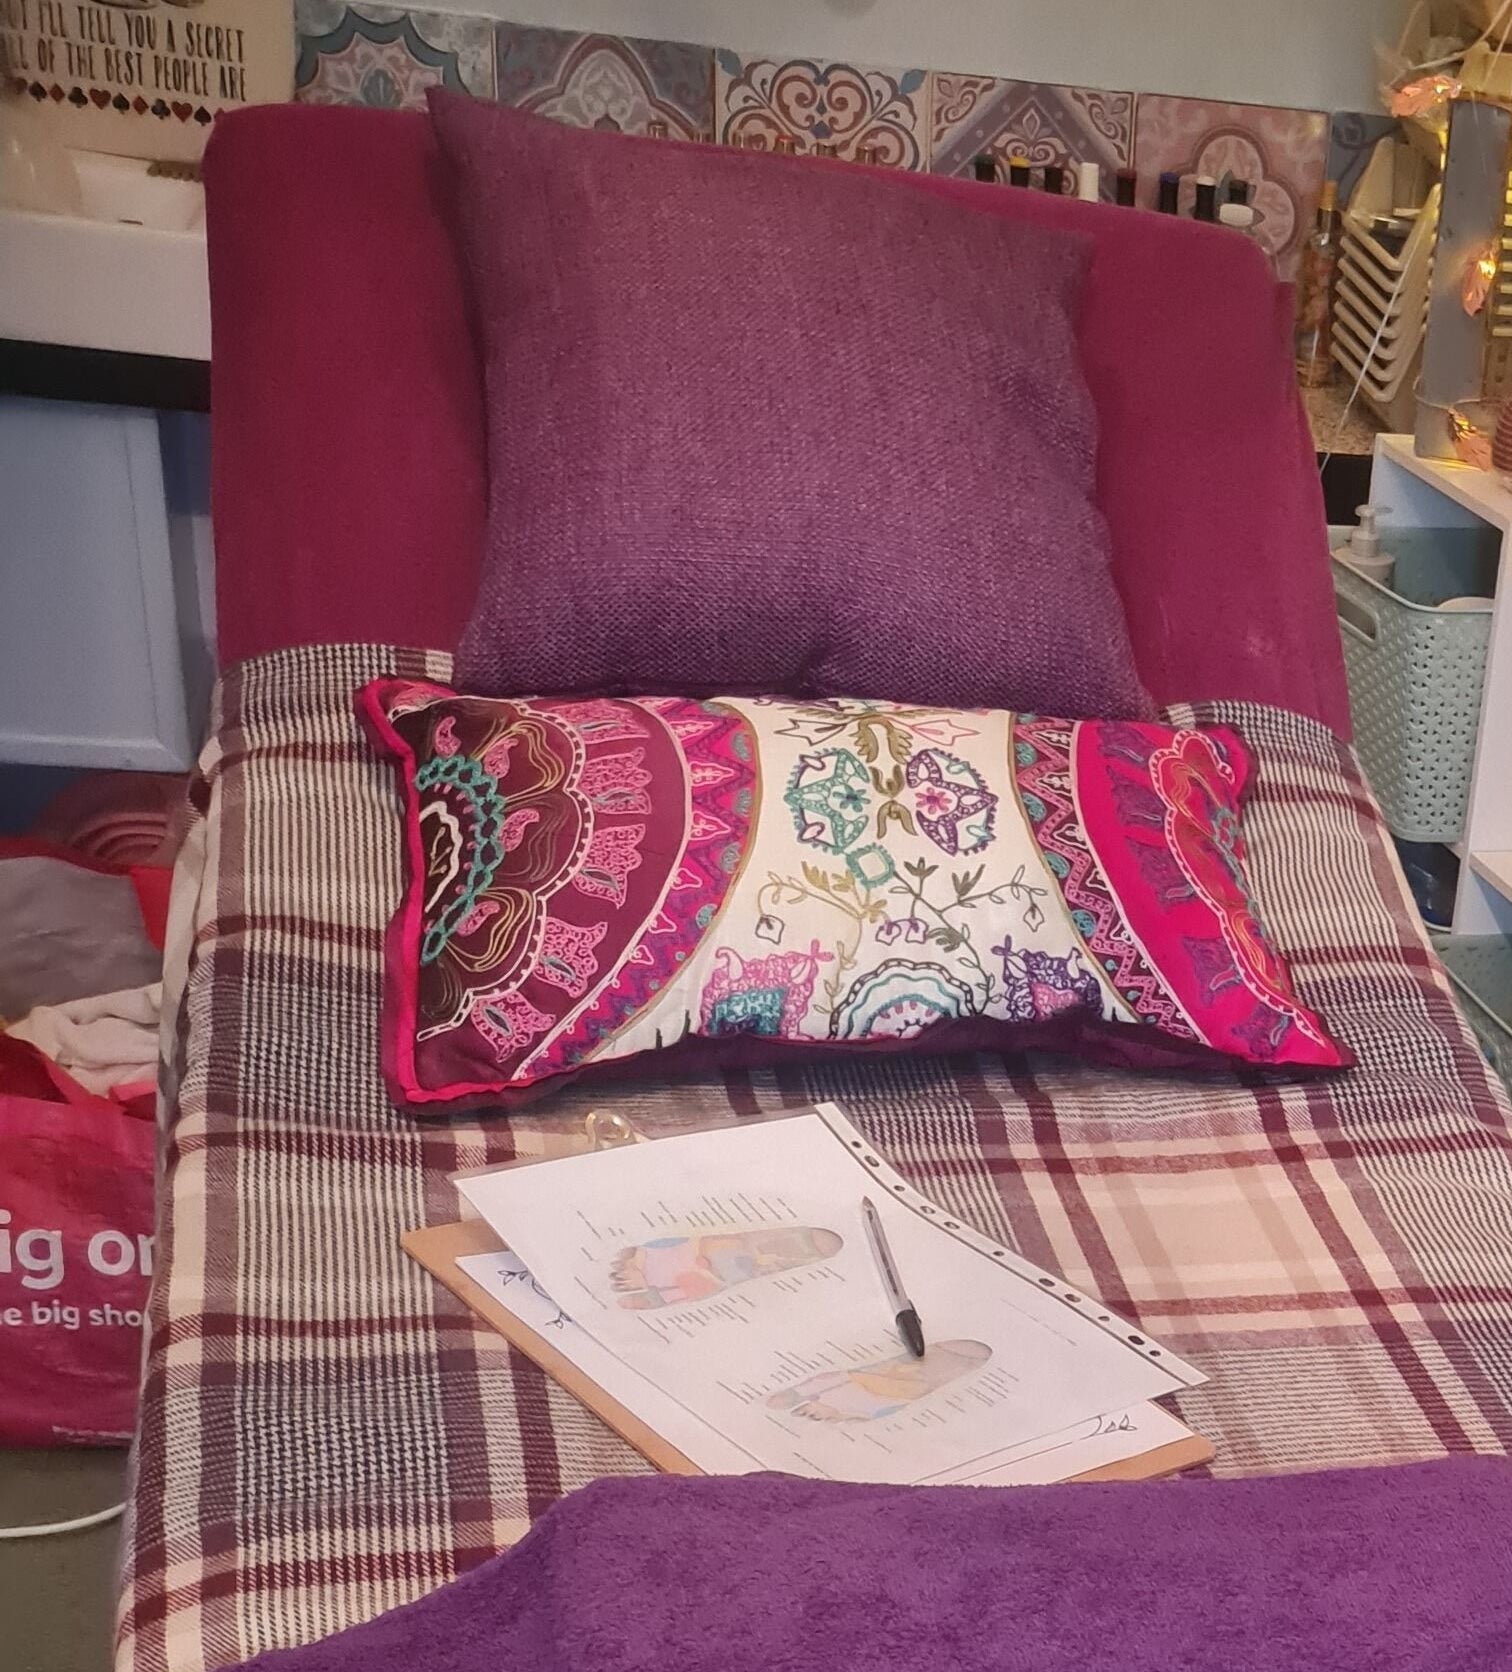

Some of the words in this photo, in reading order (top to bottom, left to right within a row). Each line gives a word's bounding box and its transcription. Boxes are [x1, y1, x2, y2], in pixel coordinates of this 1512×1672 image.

[78, 5, 116, 45] TELL
[124, 12, 157, 51] YOU
[165, 18, 176, 53] A
[185, 21, 245, 63] SECRET
[37, 37, 55, 74] OF
[65, 41, 96, 80] THE
[104, 47, 143, 87] BEST
[153, 54, 210, 97] PEOPLE
[220, 64, 247, 102] ARE
[31, 1299, 80, 1331] big
